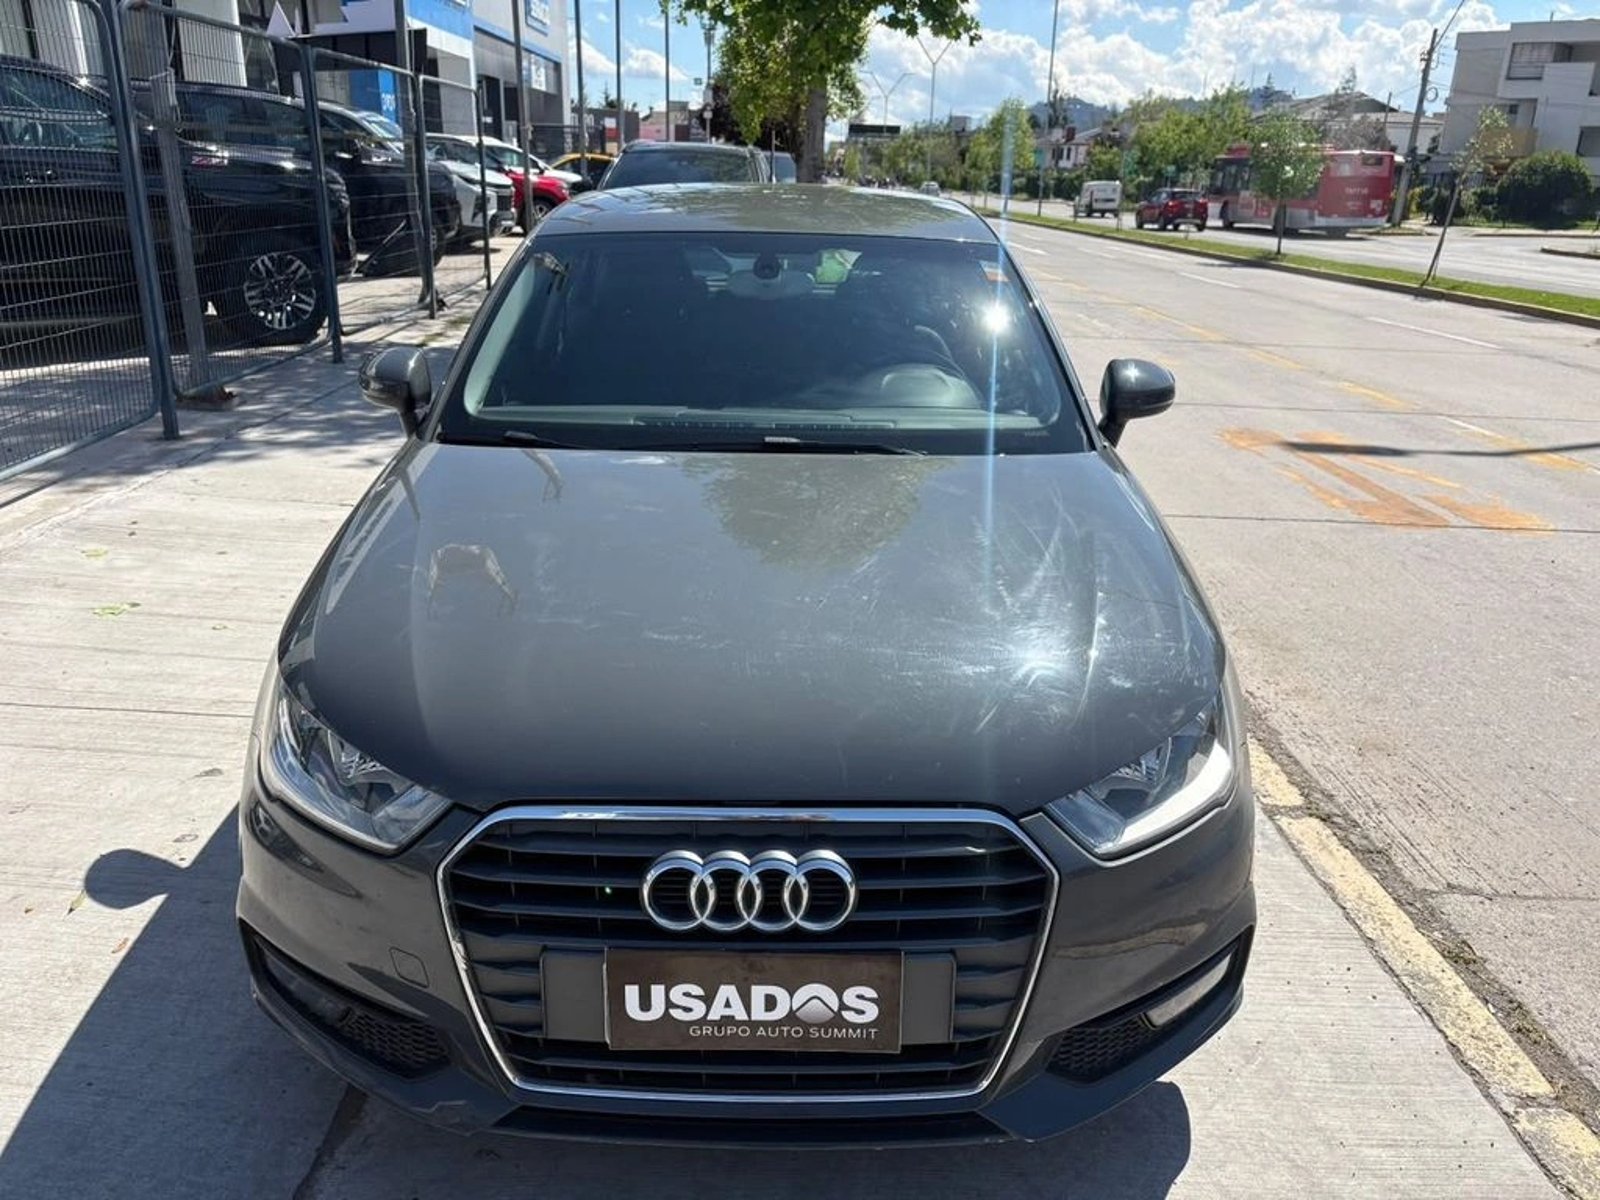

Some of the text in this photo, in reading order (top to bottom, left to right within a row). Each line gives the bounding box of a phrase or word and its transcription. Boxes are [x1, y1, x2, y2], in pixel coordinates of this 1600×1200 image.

[624, 983, 879, 1024] USADOS
[689, 1025, 879, 1040] GRUPO AUTO SUMMIT
